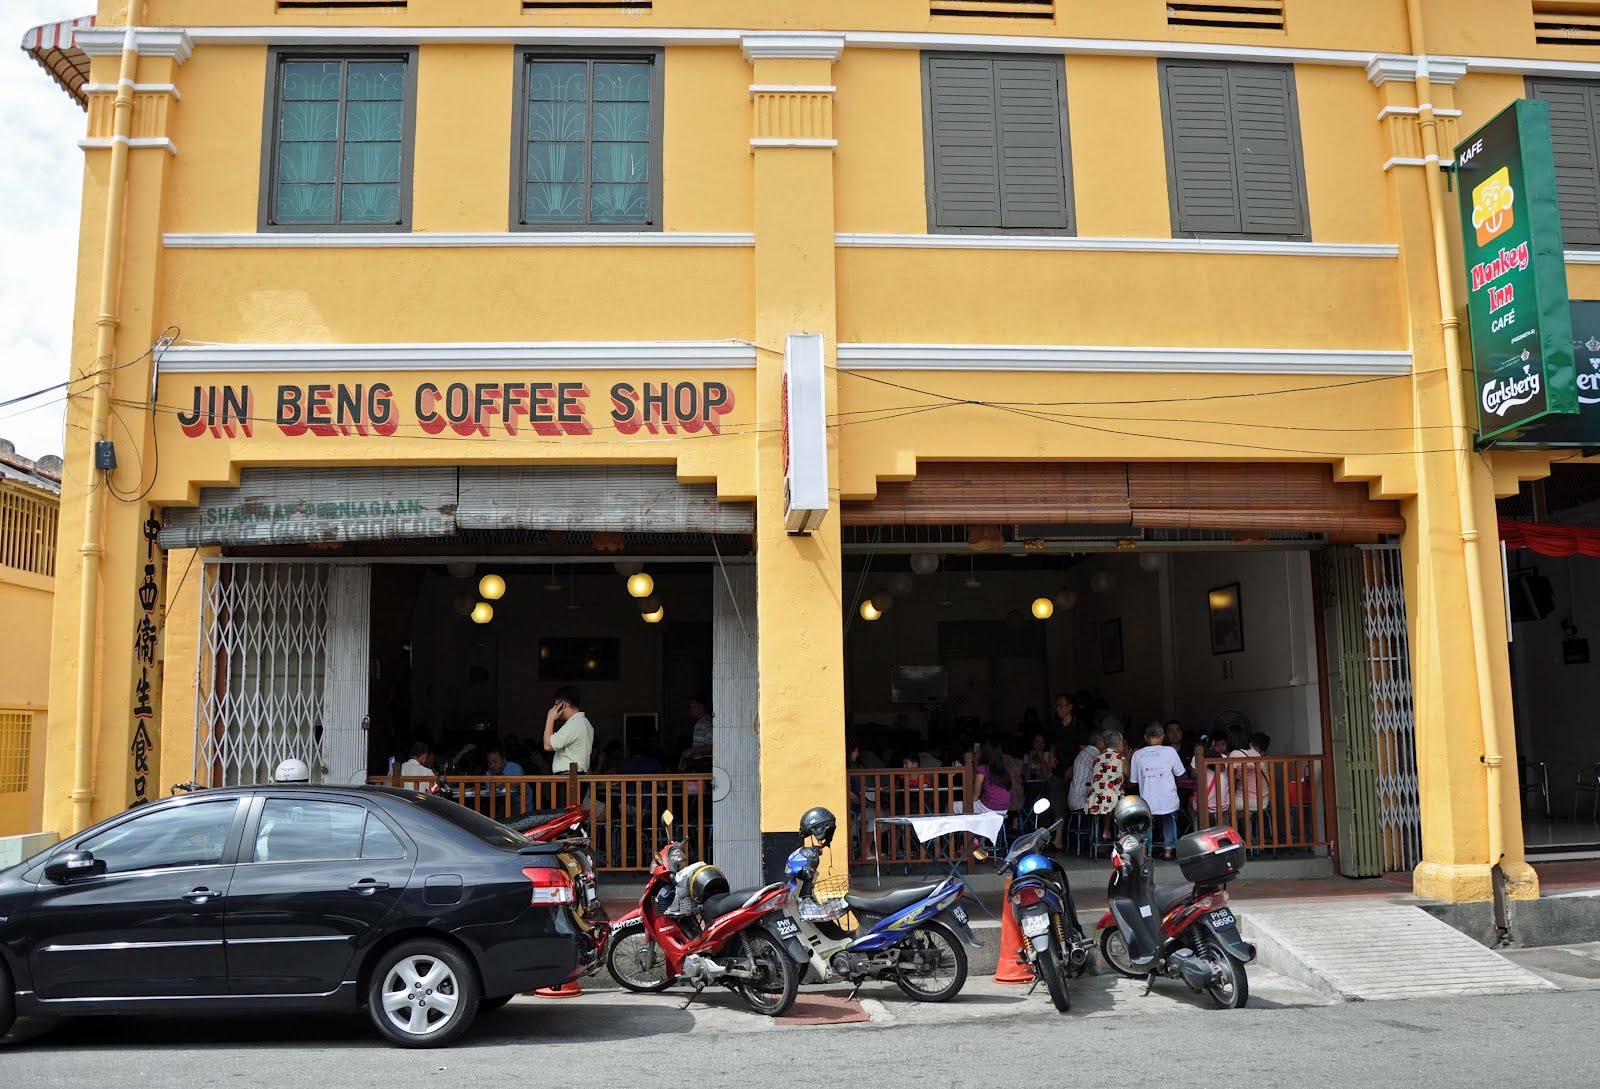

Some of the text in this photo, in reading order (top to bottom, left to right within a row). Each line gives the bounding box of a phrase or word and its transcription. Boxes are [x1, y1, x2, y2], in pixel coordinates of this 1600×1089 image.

[1460, 138, 1483, 167] KAFE
[1471, 241, 1529, 292] Monkey
[1487, 283, 1514, 314] Inn
[1491, 308, 1515, 333] CAFÉ
[1482, 371, 1540, 414] Carlsberg
[177, 385, 253, 438] JIN
[276, 383, 398, 437] BENG
[415, 382, 592, 437] COFFEE
[610, 381, 735, 436] SHOP
[776, 917, 791, 929] PHY
[1211, 909, 1228, 920] PHB
[1212, 915, 1235, 928] 6690
[778, 922, 798, 935] 2208
